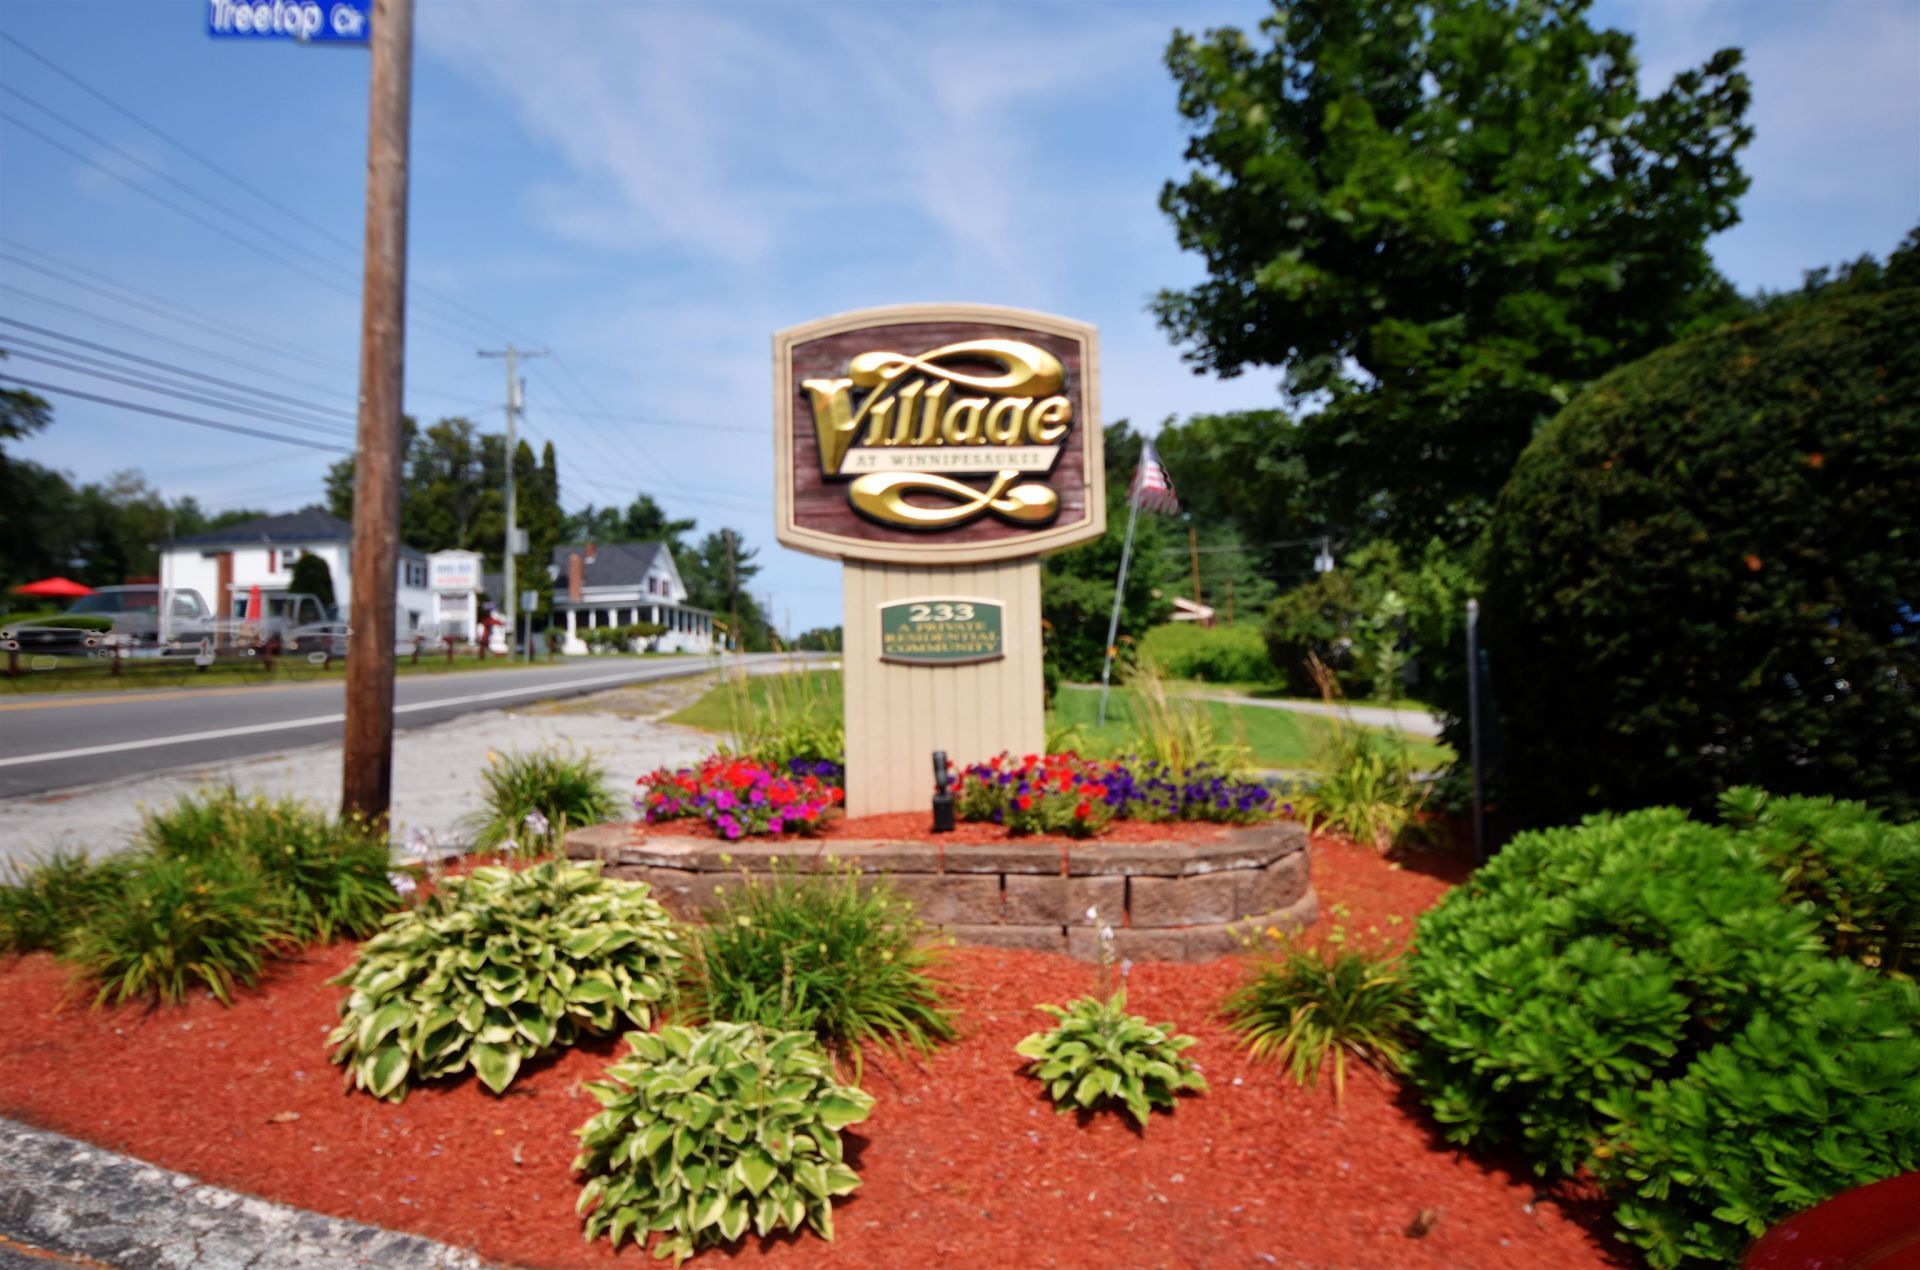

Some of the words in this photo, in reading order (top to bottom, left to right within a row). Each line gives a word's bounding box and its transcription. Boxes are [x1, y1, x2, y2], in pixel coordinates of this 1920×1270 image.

[211, 0, 324, 40] Treetop
[801, 377, 1073, 476] Village
[855, 454, 877, 468] AT
[908, 603, 976, 622] 233
